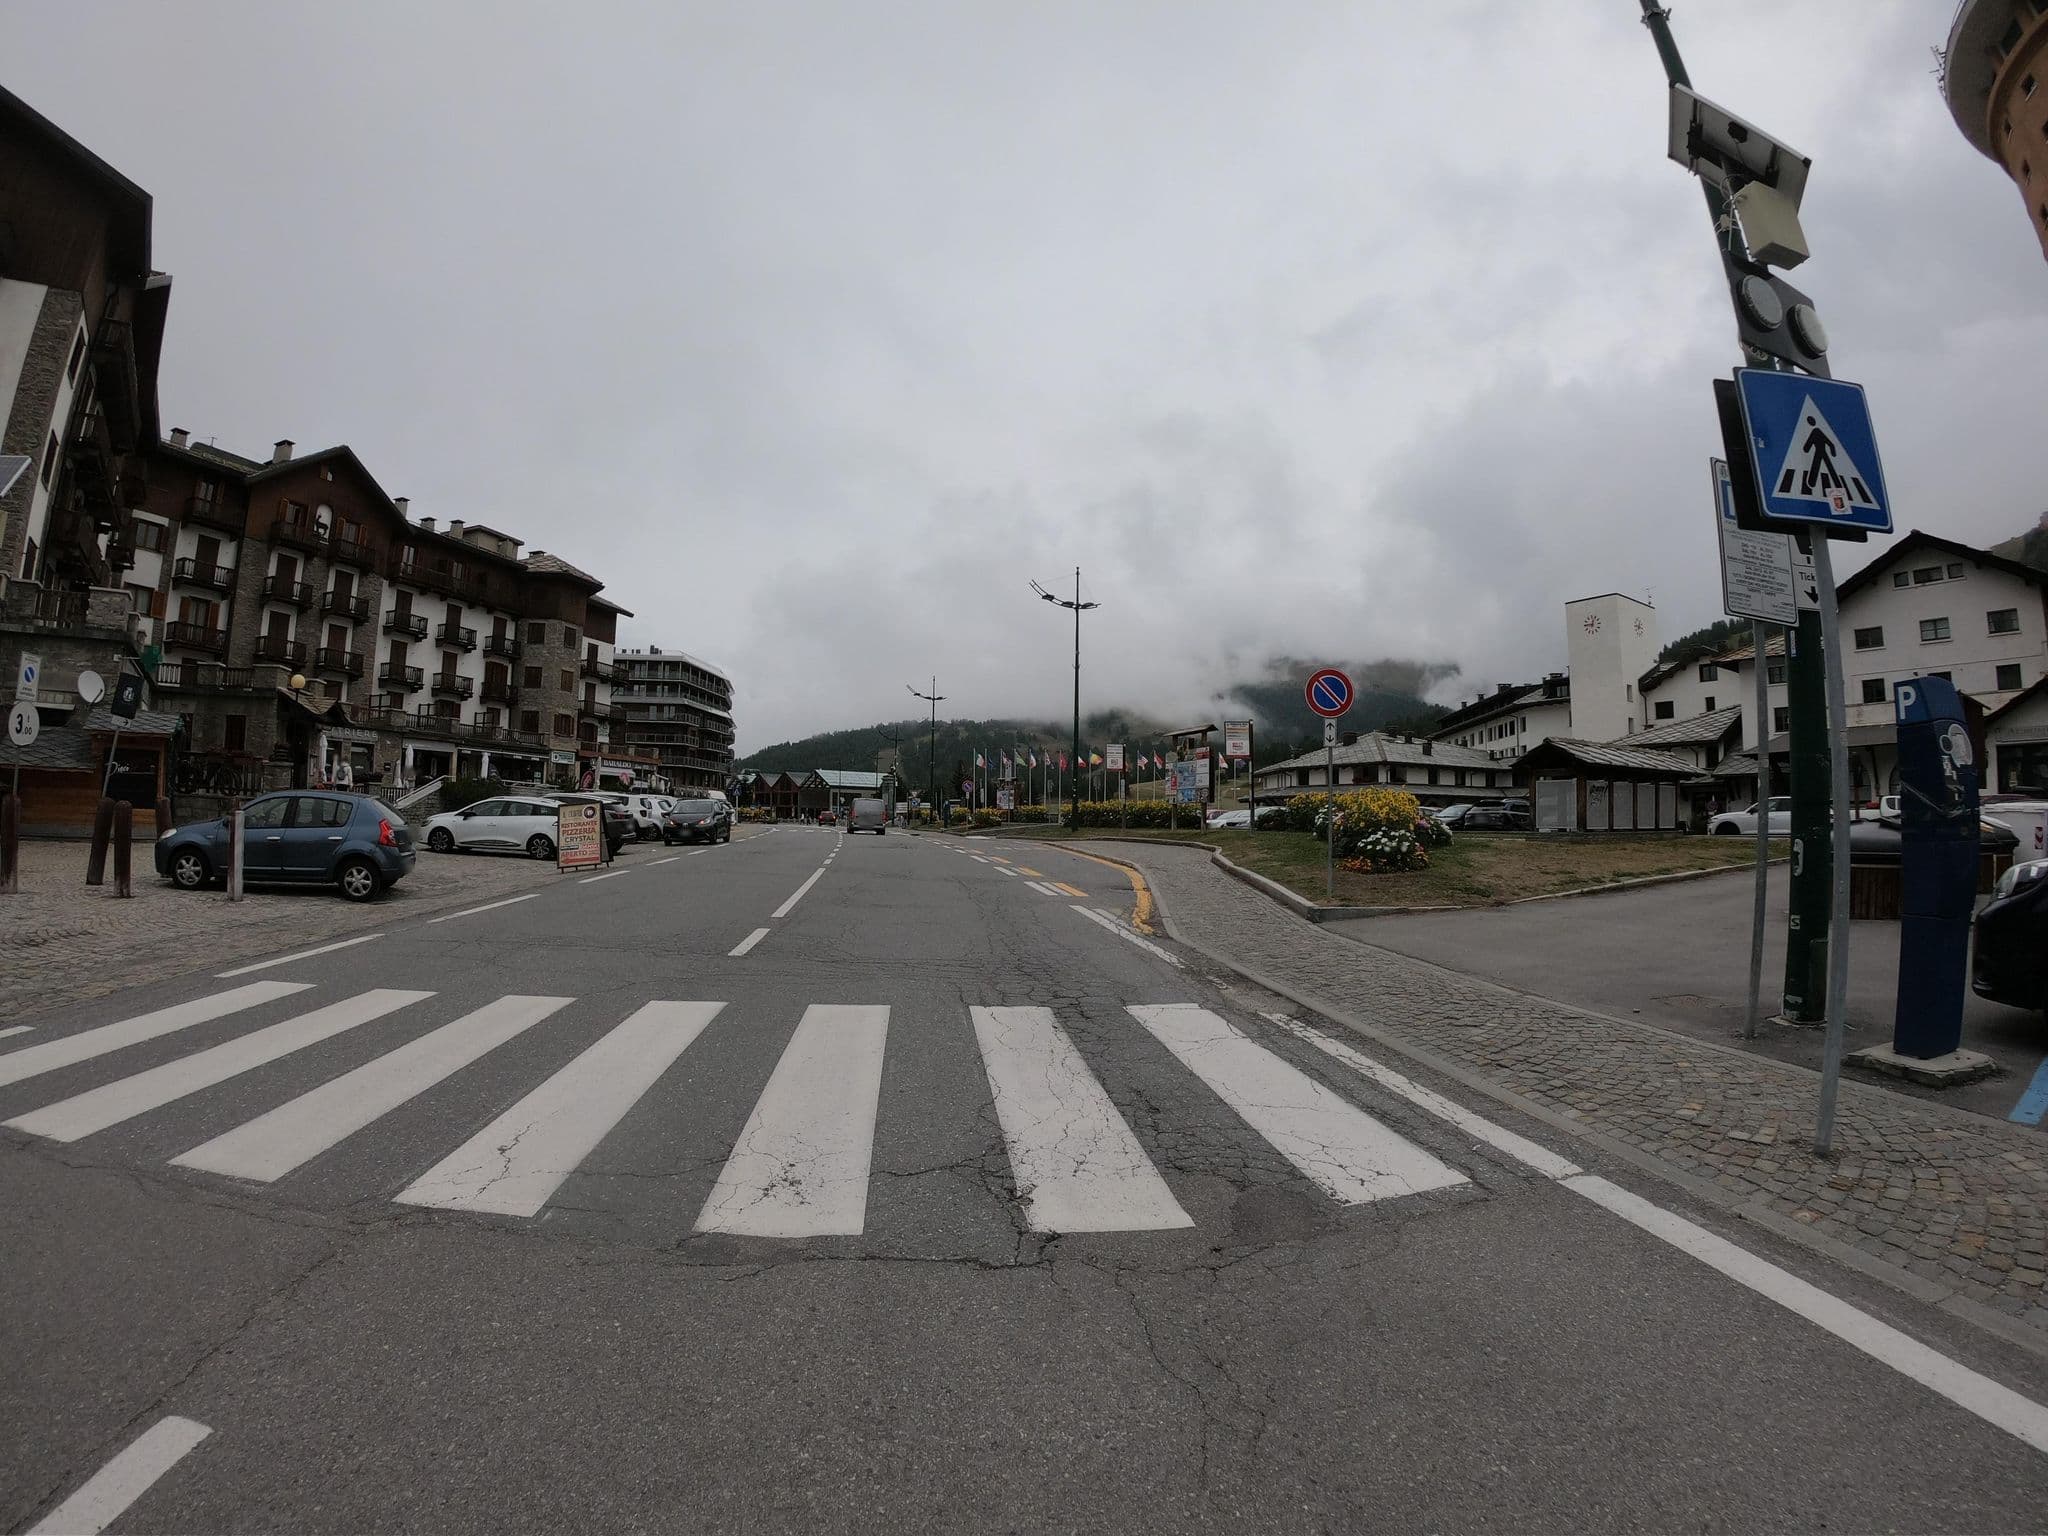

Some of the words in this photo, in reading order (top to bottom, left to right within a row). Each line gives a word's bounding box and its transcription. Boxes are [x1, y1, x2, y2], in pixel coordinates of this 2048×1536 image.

[1798, 571, 1816, 581] Tick
[1898, 685, 1916, 720] P
[561, 821, 598, 829] RISTORANTE
[562, 827, 597, 836] PIZZERIA
[564, 835, 595, 843] CRYSTAL
